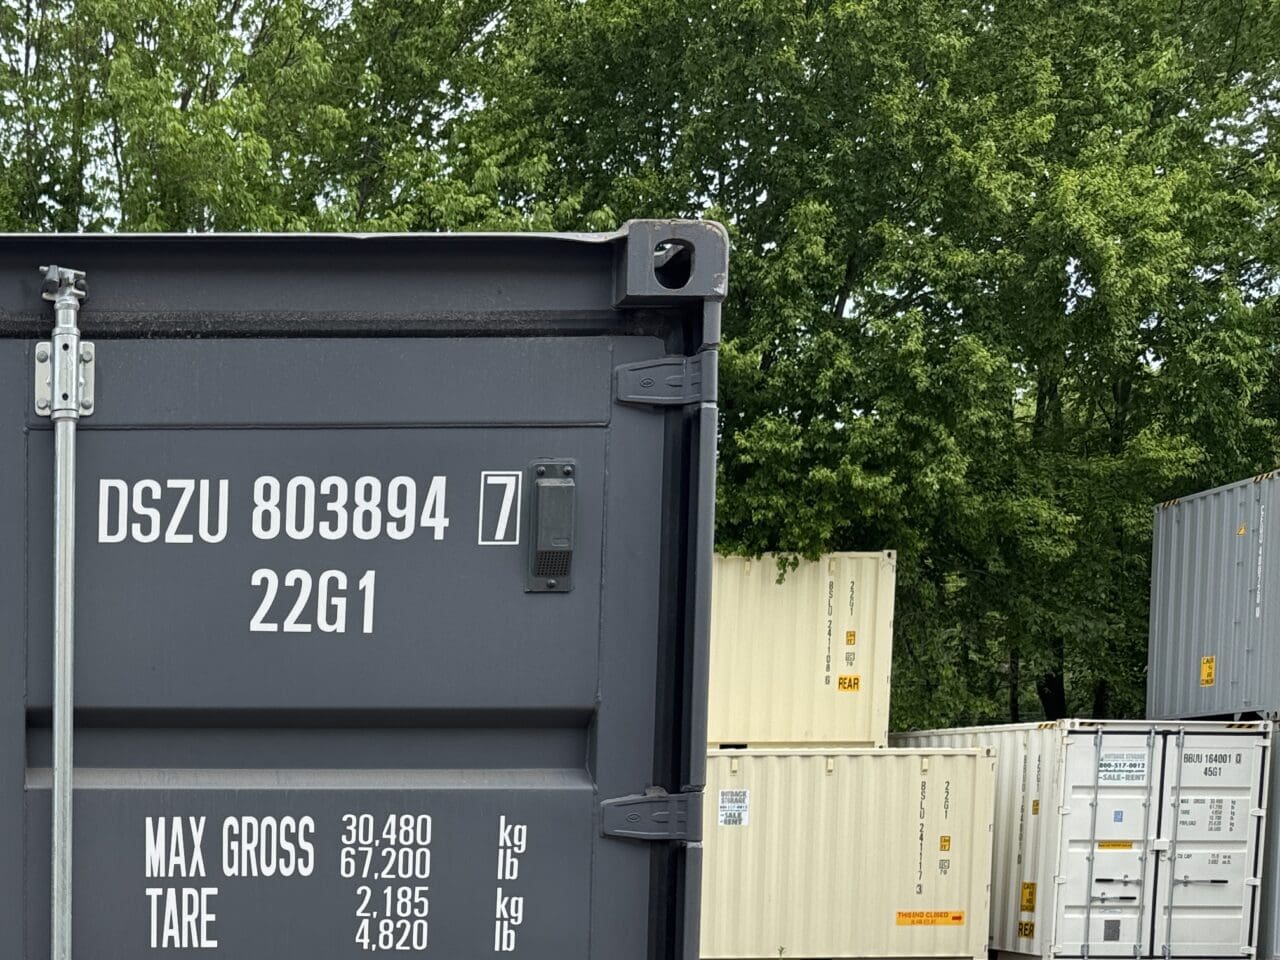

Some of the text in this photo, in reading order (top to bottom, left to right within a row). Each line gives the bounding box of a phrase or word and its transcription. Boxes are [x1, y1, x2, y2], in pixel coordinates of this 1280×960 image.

[98, 475, 515, 544] DSZU 803894 7
[249, 568, 376, 633] 22G1
[838, 678, 859, 690] REAR
[1204, 767, 1221, 776] 45G1
[1205, 754, 1231, 763] 164001
[145, 814, 527, 877] MAX GROSS 30,480 kg
[340, 848, 518, 880] 67,200 lb
[145, 886, 523, 948] TARE 2,185 kg
[355, 919, 515, 952] 4,820 lb
